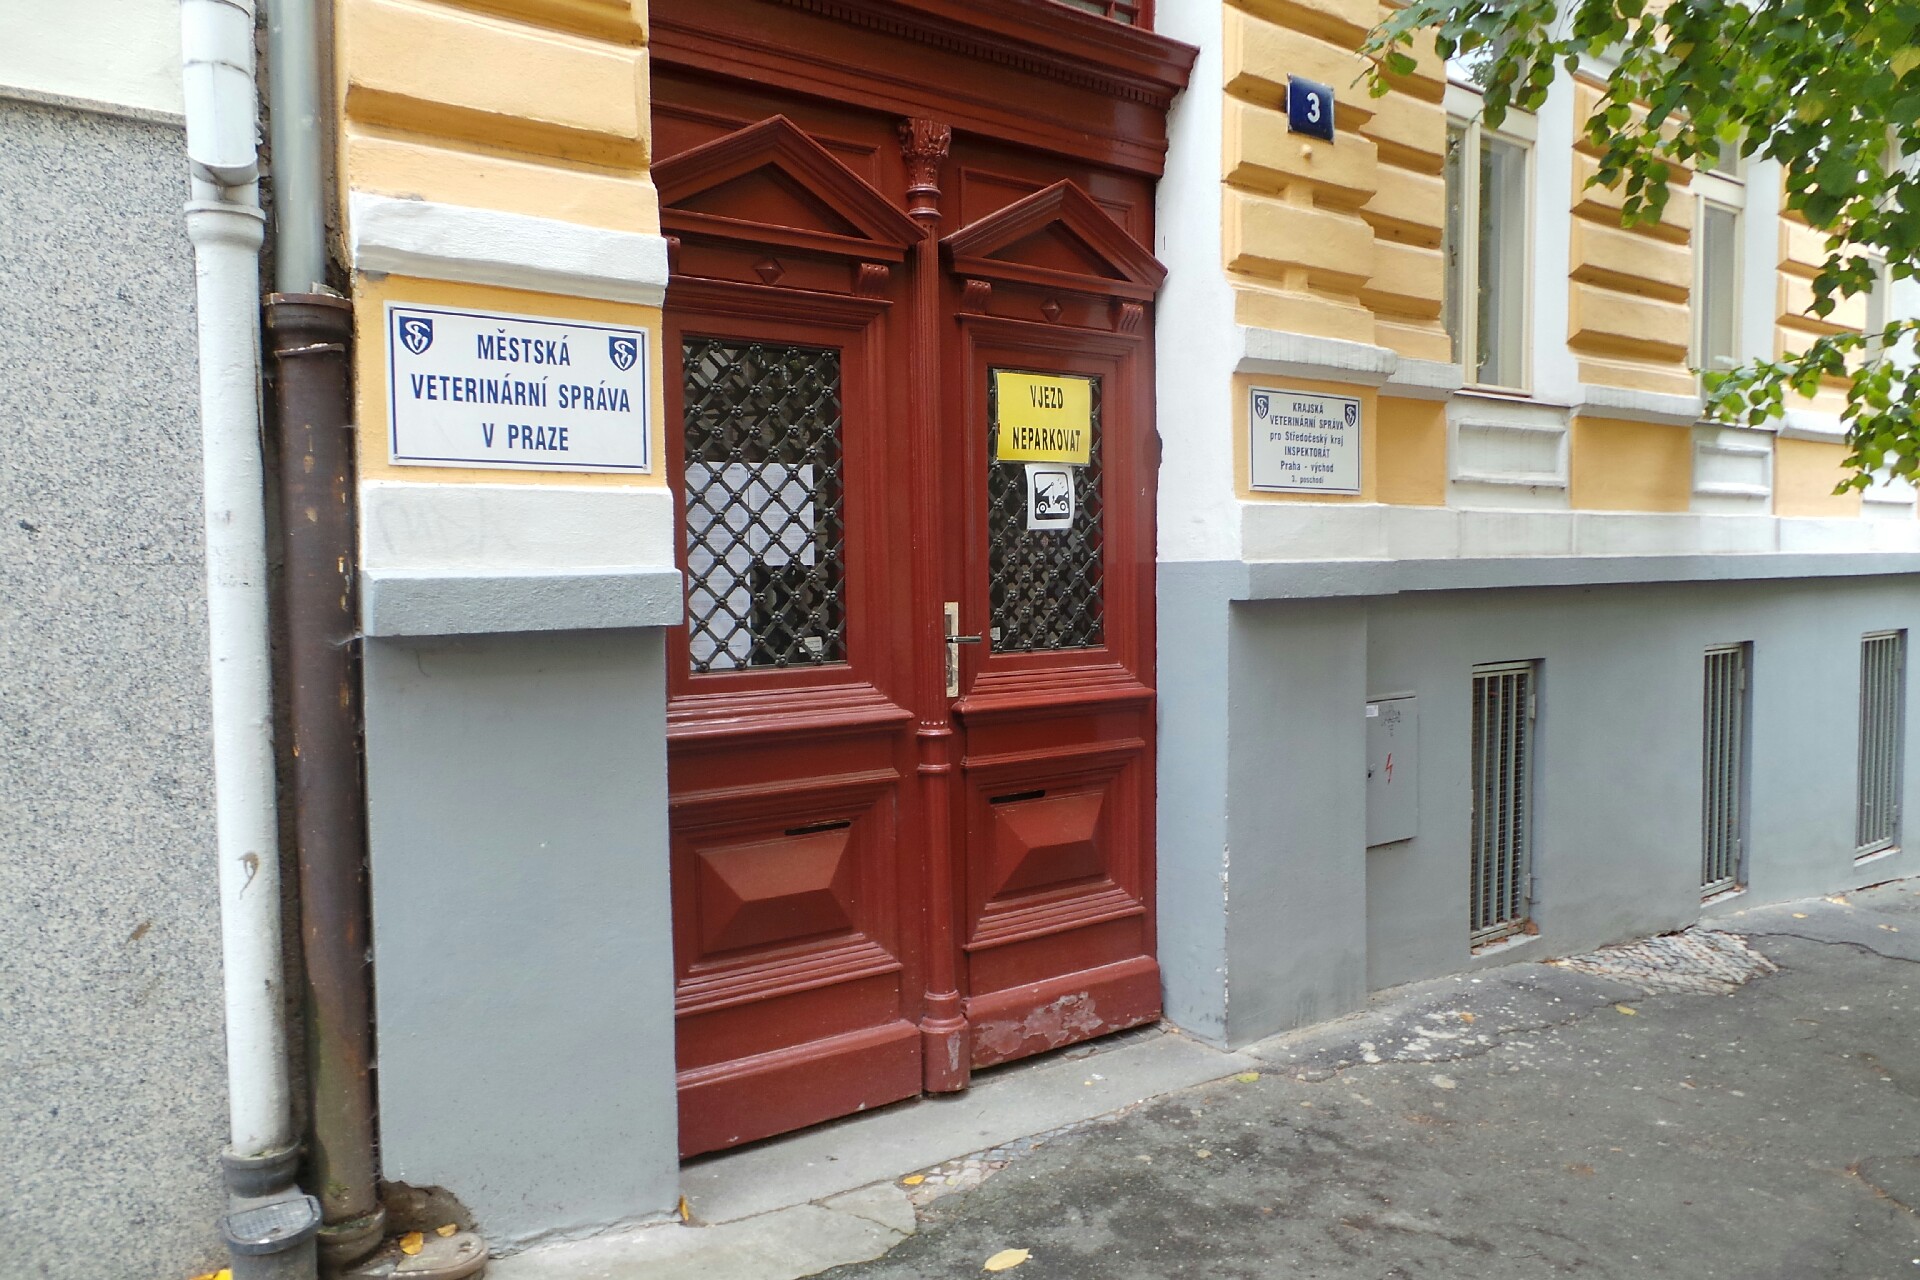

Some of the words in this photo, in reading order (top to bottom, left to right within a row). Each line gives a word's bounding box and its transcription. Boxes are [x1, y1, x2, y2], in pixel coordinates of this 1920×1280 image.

[1306, 92, 1320, 123] 3
[477, 328, 571, 366] MĚSTSKÁ
[411, 373, 548, 408] VETERINÁRNÍ
[559, 380, 631, 413] SPRÁVA
[1030, 385, 1064, 409] VJEZD
[1292, 402, 1323, 414] KRAJSKÁ
[1270, 415, 1316, 428] VETERINÁRNÍ
[1319, 418, 1344, 430] SPRÁVA
[482, 422, 495, 448] V
[508, 424, 569, 451] PRAZE
[1012, 427, 1081, 452] NEPARKOVAT
[1270, 433, 1281, 442] pro
[1285, 431, 1328, 445] Středočeský
[1330, 434, 1344, 447] kraj
[1284, 445, 1330, 458] INSPEKTORÁT
[1280, 460, 1301, 471] Praha
[1311, 461, 1334, 473] východ
